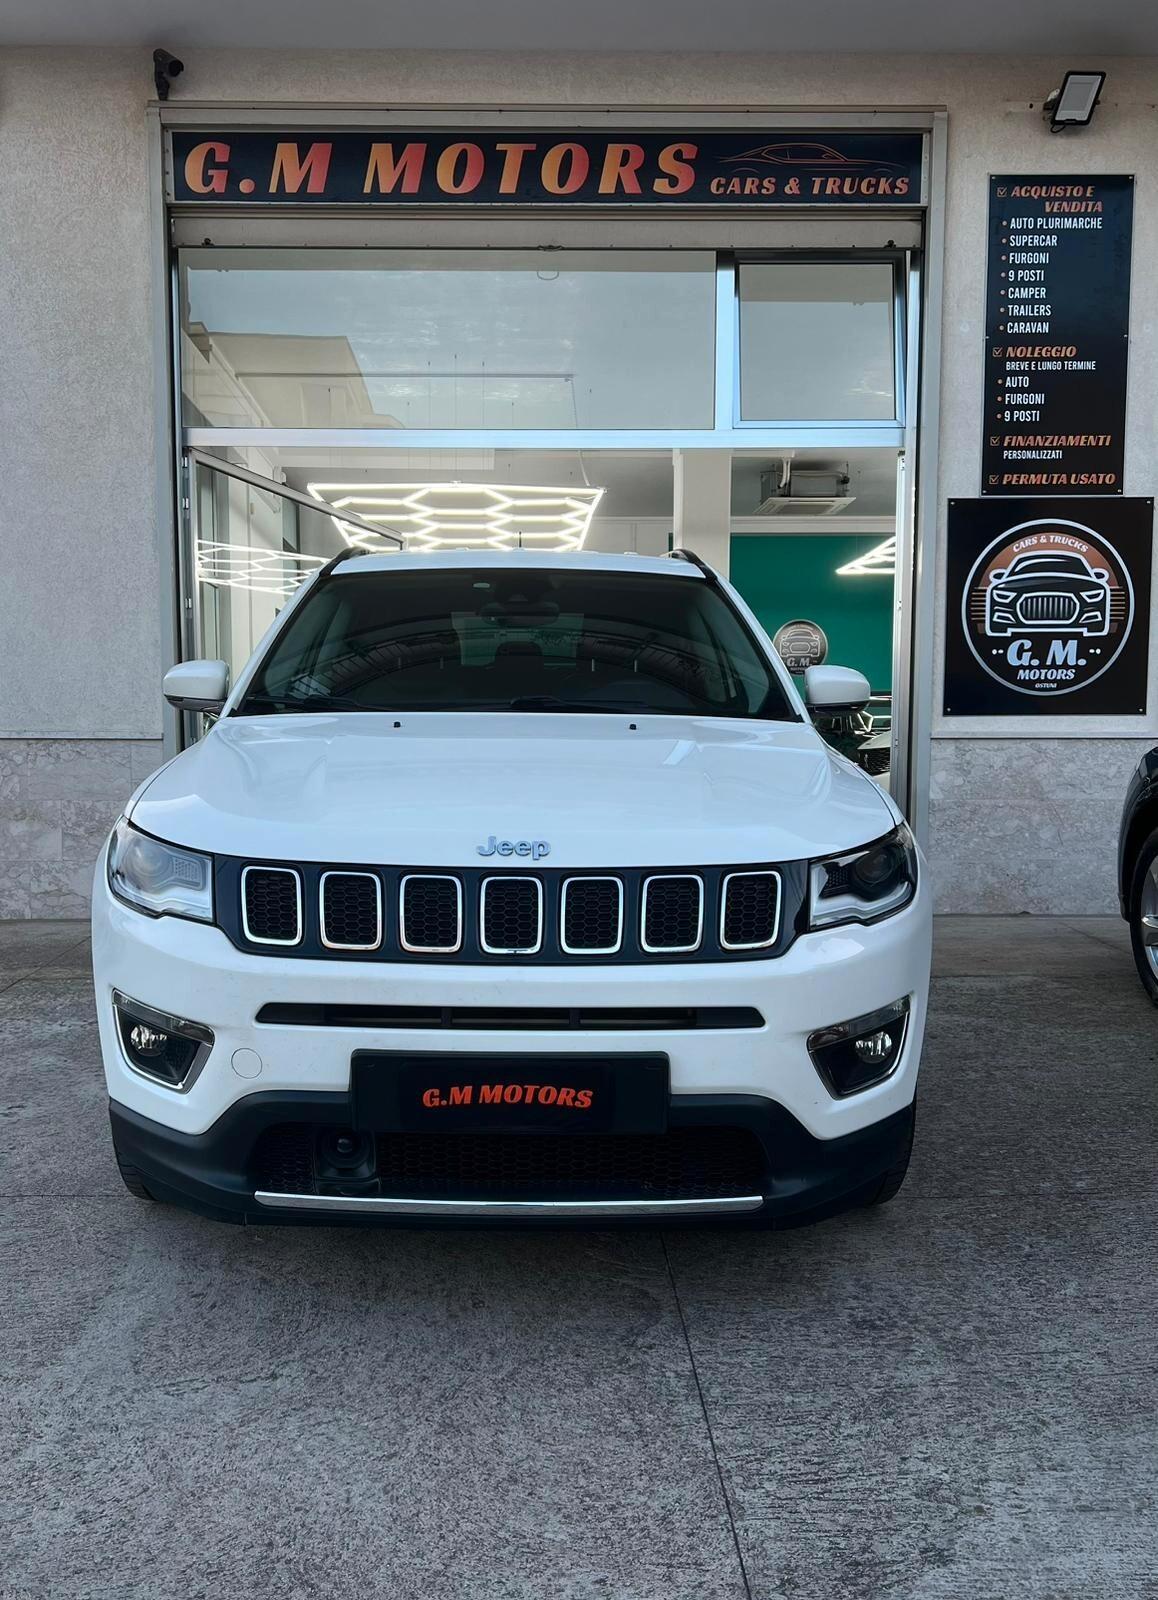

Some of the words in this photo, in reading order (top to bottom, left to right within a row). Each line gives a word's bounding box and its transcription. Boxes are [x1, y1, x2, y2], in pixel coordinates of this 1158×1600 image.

[184, 141, 333, 194] G.M
[363, 142, 699, 195] MOTORS
[710, 177, 776, 195] CARS
[784, 177, 801, 195] &
[811, 177, 909, 195] TRUCKS
[1011, 186, 1083, 199] ACQUISTO
[1086, 186, 1095, 197] E
[1045, 201, 1103, 213] VENDITA
[1010, 218, 1034, 229] AUTO
[1037, 218, 1103, 229] PLURIMARCHE
[1009, 235, 1058, 247] SUPERCAR
[1009, 253, 1049, 264] FURGONI
[1008, 270, 1015, 282] 9
[1017, 270, 1045, 281] POSTI
[1008, 288, 1046, 299] CAMPER
[1008, 305, 1051, 316] TRAILERS
[1007, 322, 1049, 334] CARAVAN
[1005, 346, 1077, 358] NOLEGGIO
[1005, 361, 1029, 371] BREVE
[1031, 361, 1036, 371] E
[1038, 361, 1062, 371] LUNGO
[1064, 361, 1096, 371] TERMINE
[1005, 376, 1029, 387] AUTO
[1005, 394, 1045, 405] FURGONI
[1004, 411, 1011, 422] 9
[1013, 411, 1040, 422] POSTI
[1003, 435, 1112, 447] FINANZIAMENTI
[1003, 450, 1063, 460] PERSONALIZZATI
[1002, 473, 1068, 485] PERMUTA
[1070, 473, 1116, 485] USATO
[1012, 536, 1038, 553] CARS
[1040, 535, 1048, 543] &
[1049, 535, 1089, 553] TRUCKS
[1017, 668, 1076, 680] MOTORS
[476, 836, 551, 860] Jeep
[422, 1085, 473, 1108] G.M
[479, 1084, 594, 1108] MOTORS
